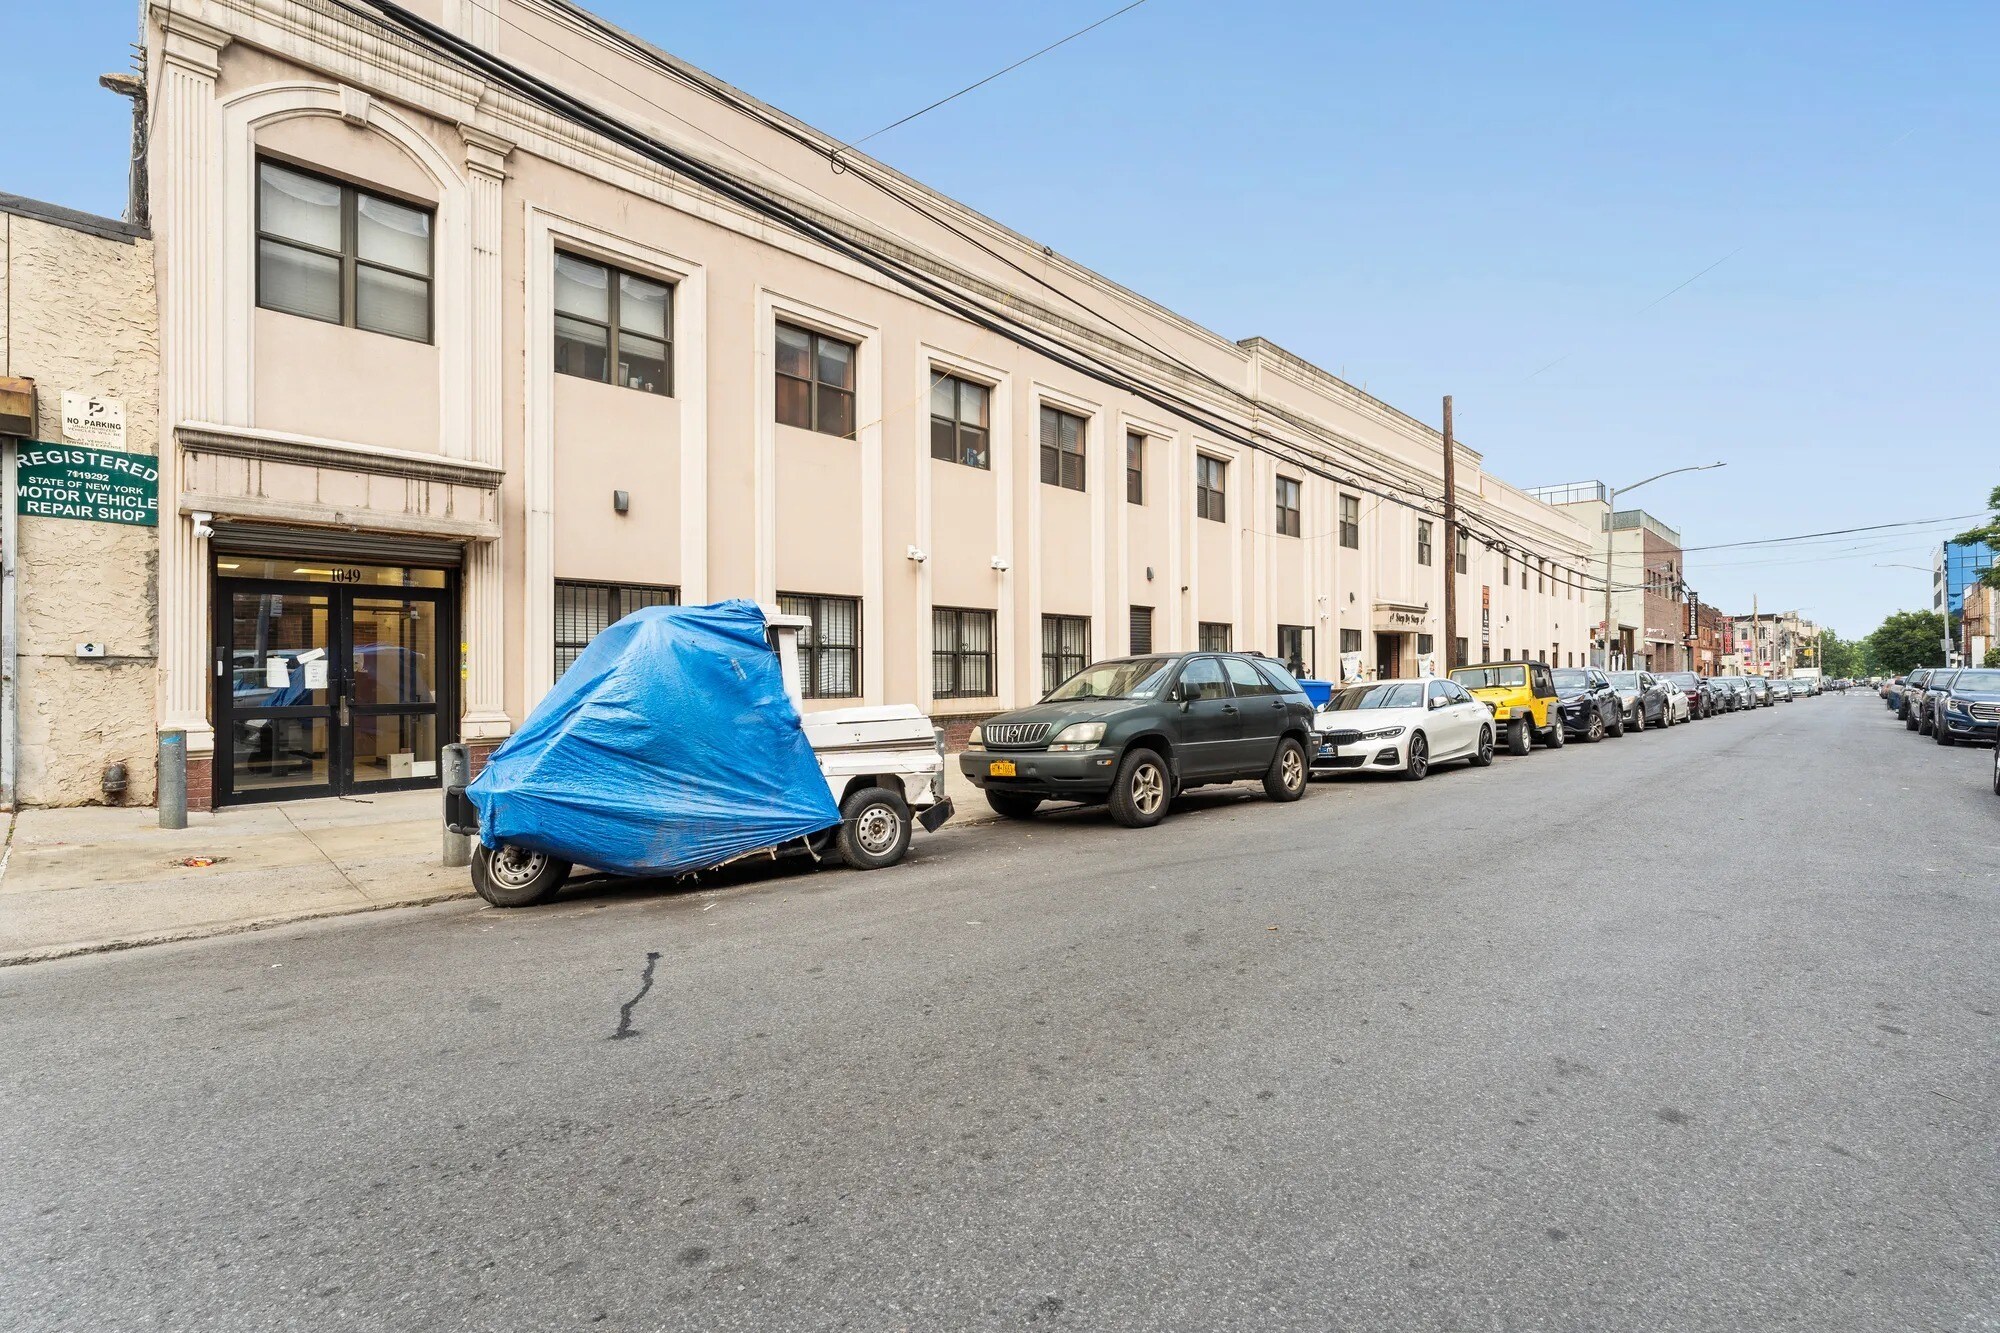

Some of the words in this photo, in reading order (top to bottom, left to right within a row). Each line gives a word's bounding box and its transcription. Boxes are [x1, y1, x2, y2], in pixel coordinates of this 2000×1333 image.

[84, 420, 121, 430] PARKING
[17, 450, 158, 481] REGISTERED
[28, 476, 65, 487] STATE
[67, 480, 82, 488] OF
[85, 482, 111, 491] NEW
[113, 484, 144, 495] YORK
[17, 485, 80, 502] MOTOR
[84, 491, 158, 510] VEHICLE
[26, 500, 93, 518] REPAIR
[98, 507, 146, 521] SHOP
[330, 567, 361, 583] 1049
